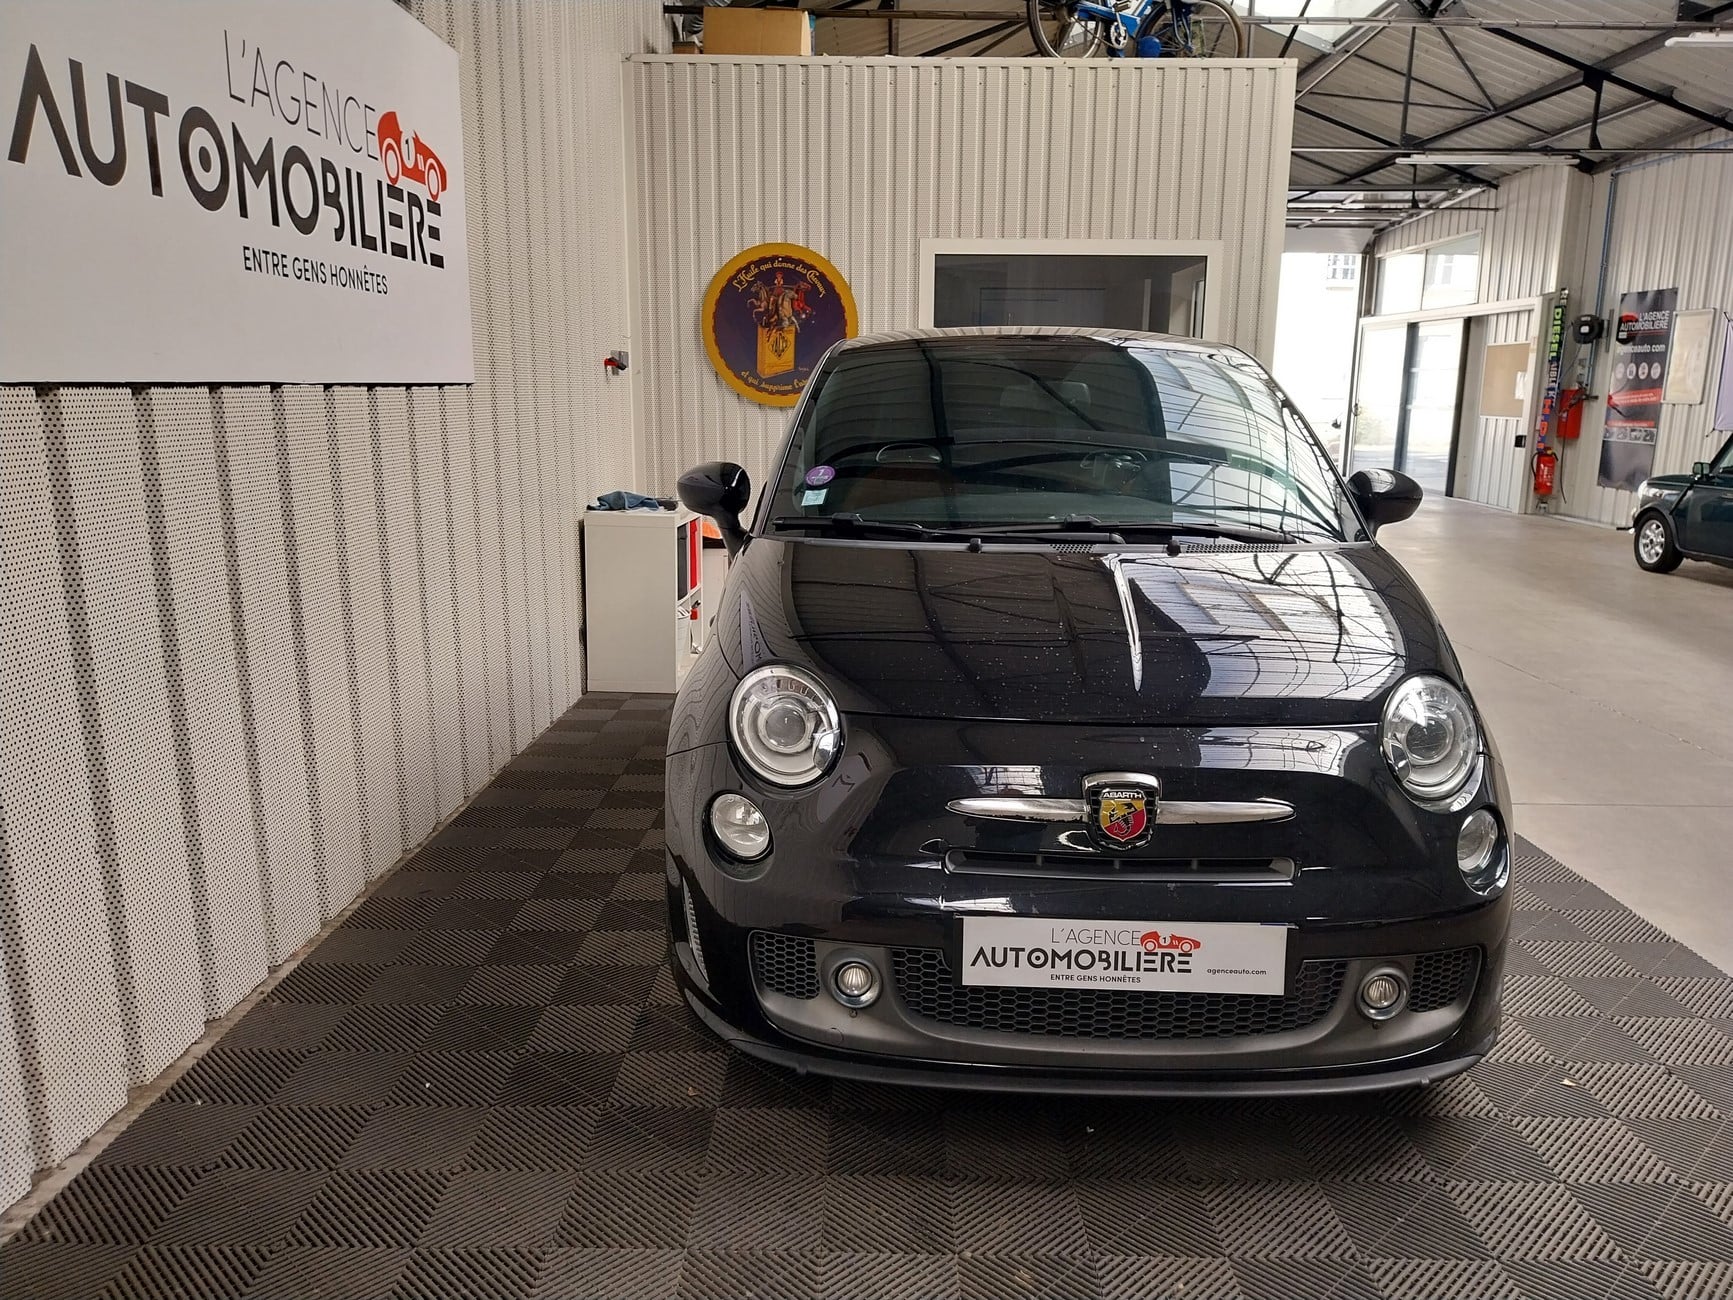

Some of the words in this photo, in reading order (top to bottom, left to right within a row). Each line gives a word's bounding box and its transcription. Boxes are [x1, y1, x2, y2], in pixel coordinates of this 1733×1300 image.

[224, 29, 379, 161] L'AGENCE
[8, 43, 445, 269] AUTOMOBILIERE
[242, 245, 290, 279] ENTRE
[292, 256, 328, 285] GENS
[330, 264, 389, 296] HONNÊTES
[760, 261, 773, 272] qui
[773, 260, 795, 270] donne
[795, 264, 807, 274] des
[1639, 310, 1670, 322] L'AGENCE
[1548, 307, 1563, 361] DIESEL
[1103, 791, 1142, 799] ABARTH
[1051, 927, 1141, 946] L'AGENCE
[970, 946, 1193, 974] AUTOMOBILIERE
[1050, 973, 1075, 982] ENTRE
[1076, 974, 1098, 983] GENS
[1099, 974, 1141, 984] HONNÊTES
[1207, 967, 1267, 976] agenceauto.com
